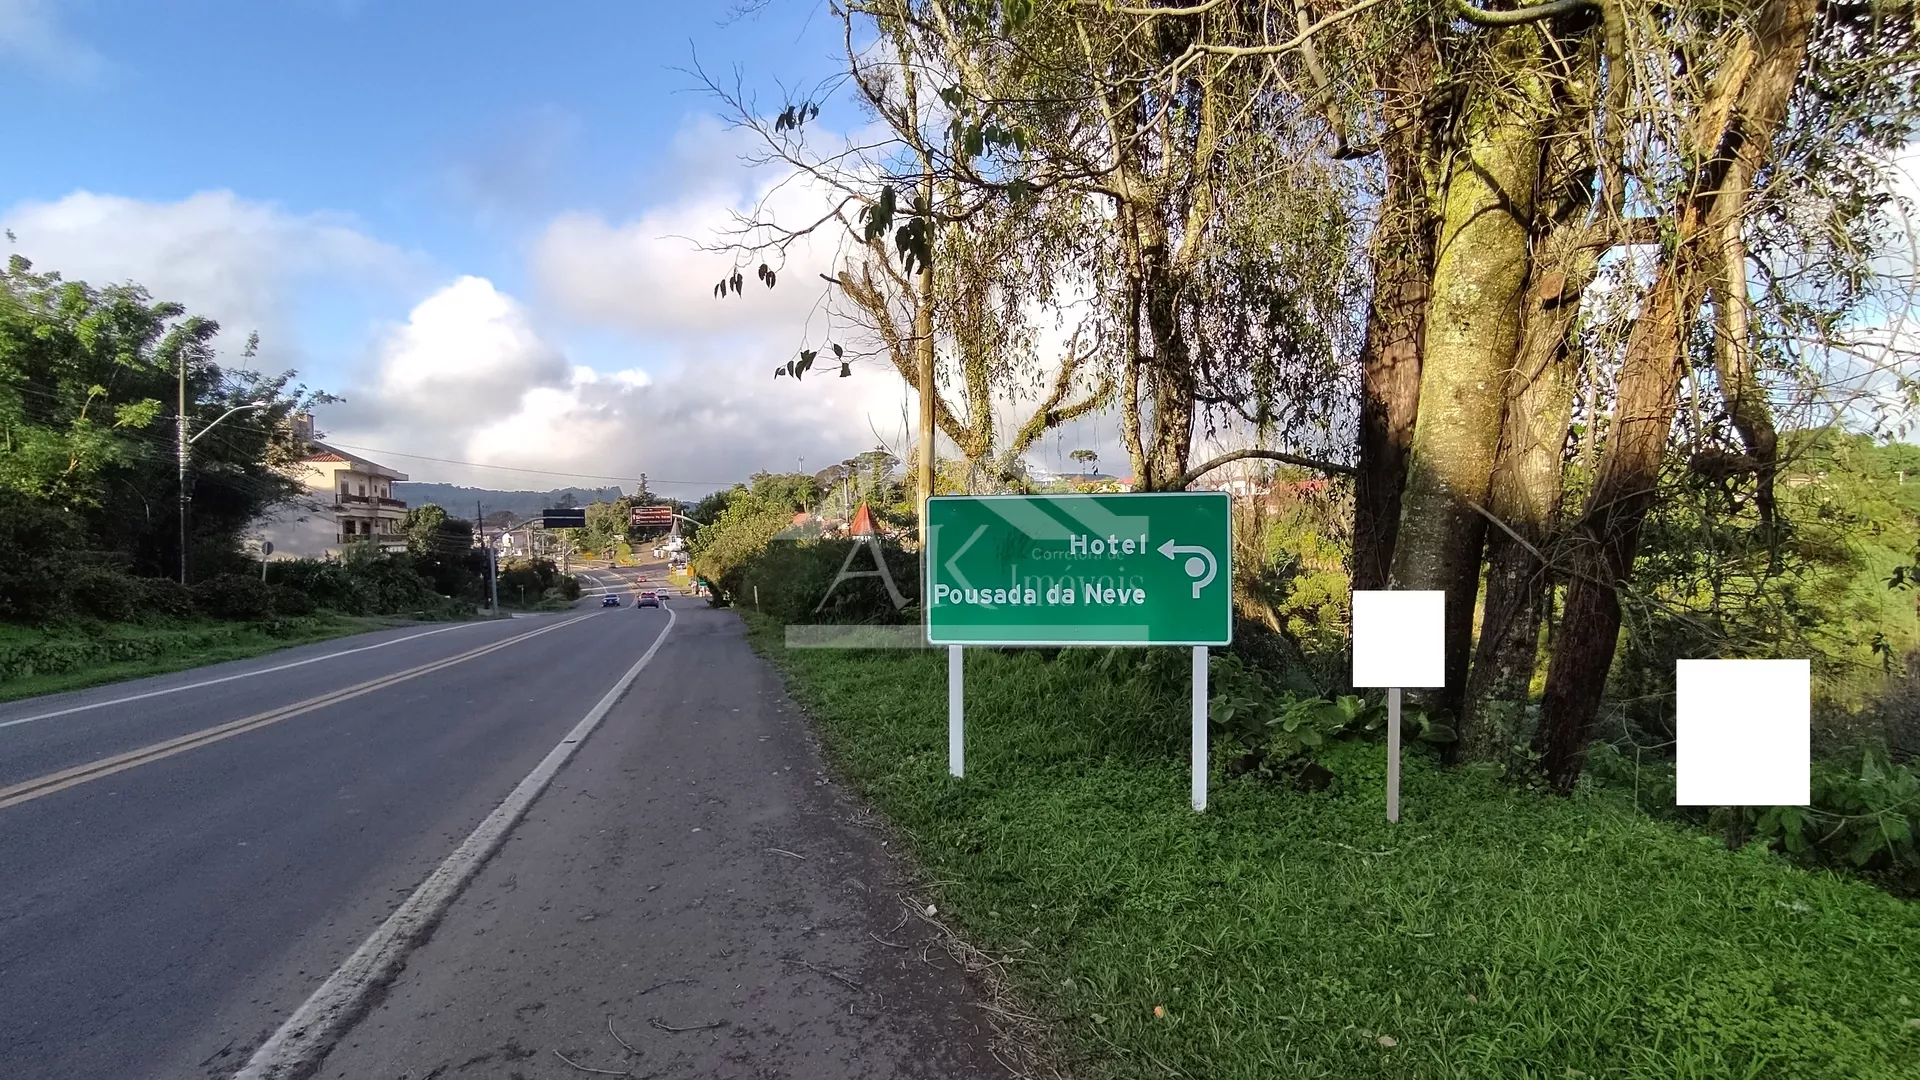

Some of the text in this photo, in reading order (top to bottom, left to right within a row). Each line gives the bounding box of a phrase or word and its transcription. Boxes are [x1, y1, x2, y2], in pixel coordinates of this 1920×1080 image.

[1069, 533, 1146, 555] Hotel
[934, 583, 1147, 604] Pousada da Neve
